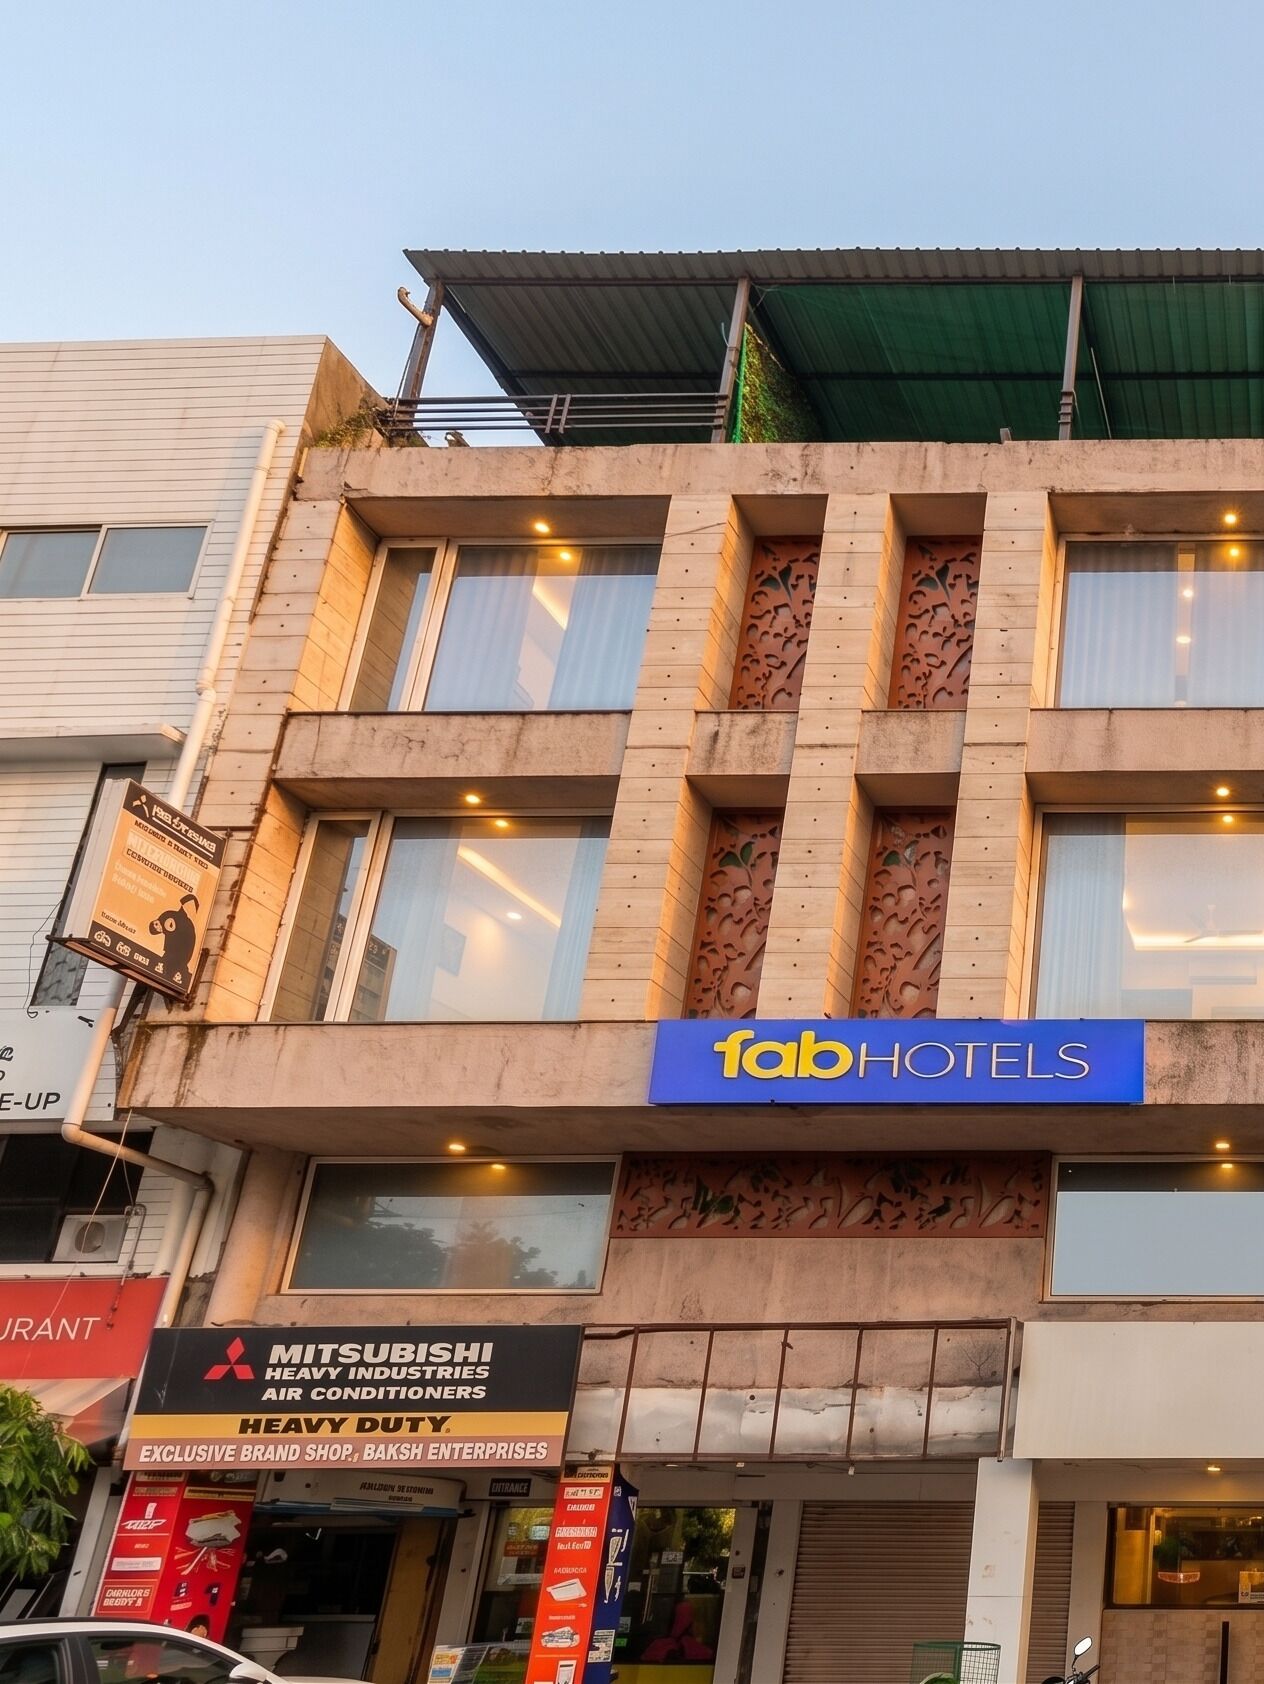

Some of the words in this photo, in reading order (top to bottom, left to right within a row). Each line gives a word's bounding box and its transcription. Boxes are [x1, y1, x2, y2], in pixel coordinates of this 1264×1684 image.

[268, 1342, 494, 1364] MITSUBISHI
[265, 1367, 342, 1381] HEAVY
[348, 1365, 490, 1380] INDUSTRIES
[261, 1387, 304, 1401] AIR
[310, 1386, 487, 1400] CONDITIONERS
[238, 1417, 349, 1435] HEAVY
[355, 1415, 451, 1434] DUTY
[139, 1445, 238, 1463] EXCLUSIVE
[240, 1444, 301, 1462] BRAND
[362, 1443, 424, 1461] BAKSH
[427, 1442, 548, 1461] ENTERPRISES
